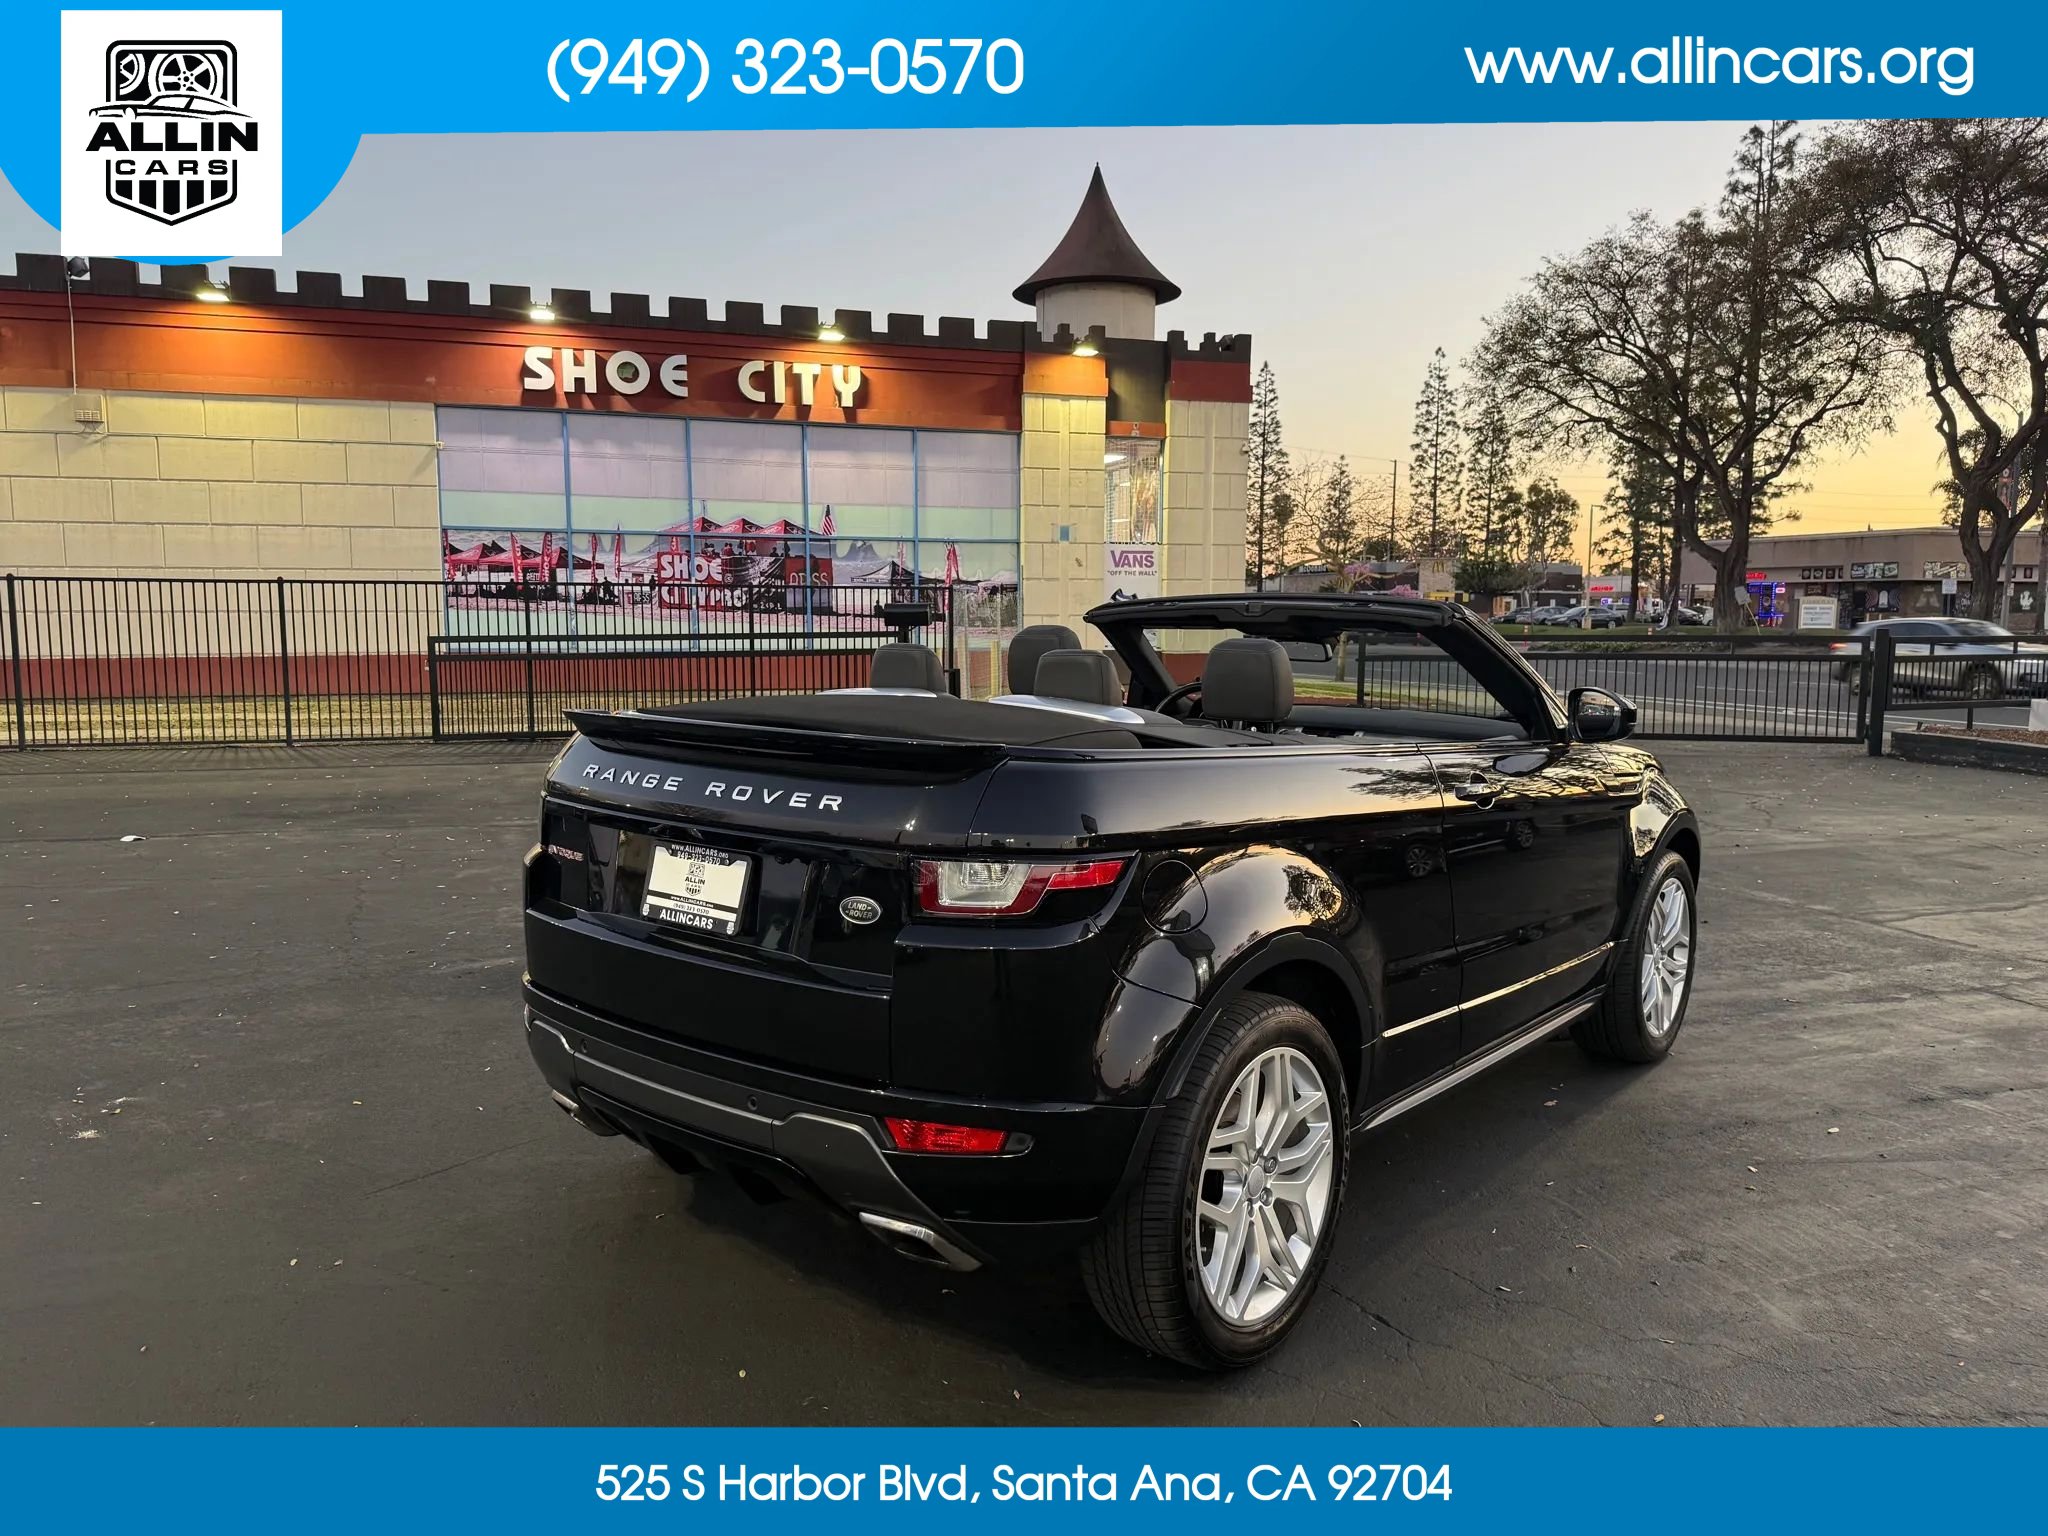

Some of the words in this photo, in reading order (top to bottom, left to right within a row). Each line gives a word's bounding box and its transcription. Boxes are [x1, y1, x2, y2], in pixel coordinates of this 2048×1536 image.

[524, 346, 688, 397] SHOE
[738, 360, 861, 407] CITY
[661, 555, 723, 580] SHOE
[1110, 550, 1154, 568] VANS
[583, 764, 684, 792] RANGE
[704, 781, 844, 812] ROVER
[685, 876, 705, 885] ALLIN
[660, 909, 714, 930] ALLINCARS
[849, 910, 873, 919] ROVER
